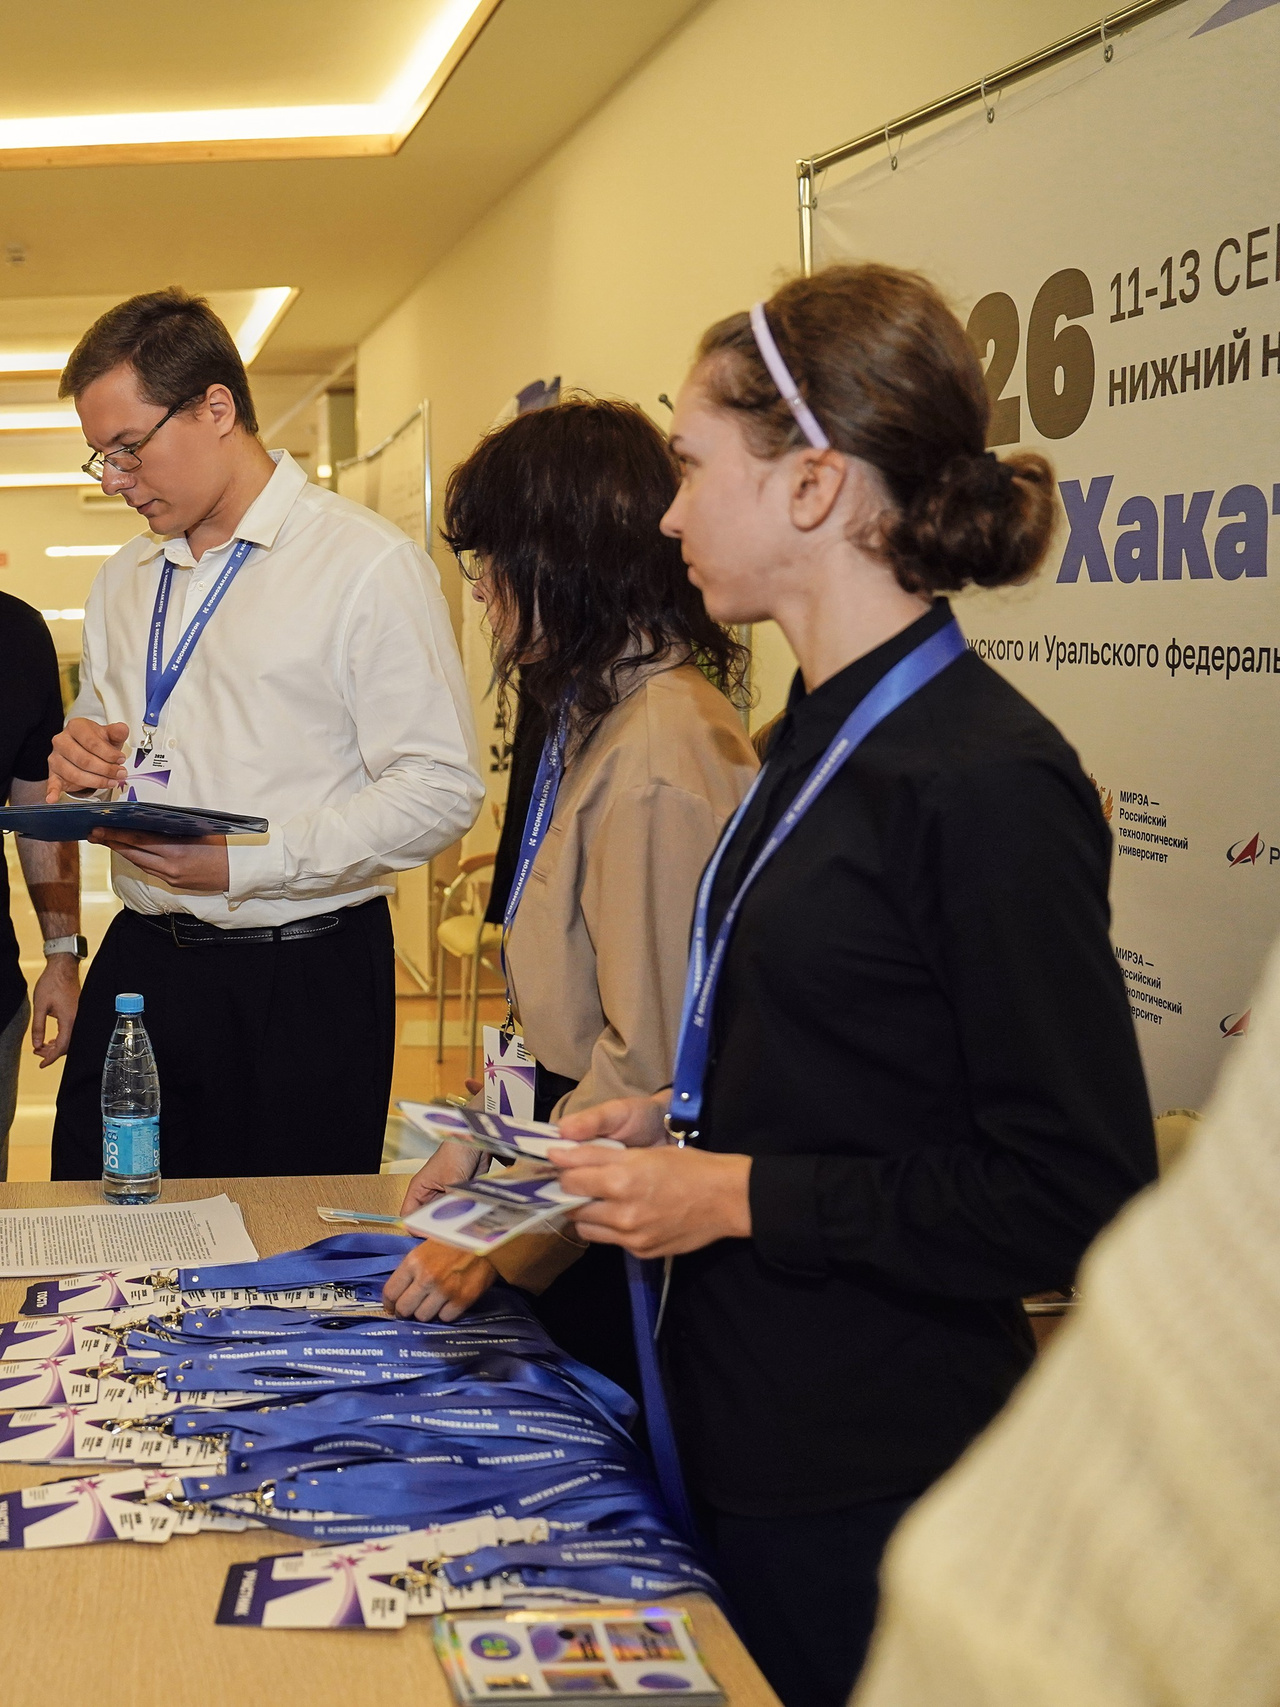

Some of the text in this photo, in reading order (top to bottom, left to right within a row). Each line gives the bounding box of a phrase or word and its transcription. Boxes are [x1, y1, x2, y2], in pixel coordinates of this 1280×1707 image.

[1109, 249, 1200, 323] 11-13
[1108, 326, 1251, 407] НИЖНИЙ
[1056, 474, 1280, 584] Хака
[206, 566, 234, 607] КОСМОХАКАТОН
[152, 628, 161, 671] КОСМОХАКАТОН
[175, 621, 200, 665] КОСМОХАКАТОН
[1029, 640, 1039, 662] и
[1044, 634, 1159, 670] Уральского
[531, 779, 551, 837] КОСМОХАКАТОН
[1120, 790, 1149, 807] МИРЭА
[1119, 807, 1167, 828] Российский
[1118, 827, 1189, 850] технологический
[1118, 844, 1168, 864] университет
[1115, 946, 1144, 966] МИРЭА
[1120, 967, 1162, 990] оссийский
[1124, 985, 1182, 1015] нологический
[1131, 1005, 1163, 1025] ерситет
[36, 1290, 48, 1308] ГОСТЬ
[220, 1349, 288, 1360] КОСМОХАКАТОН
[315, 1348, 383, 1356] КОСМОХАКАТОН
[410, 1350, 480, 1358] КОСМОХАКАТОН
[297, 1363, 366, 1377] КОСМОХАКАТОН
